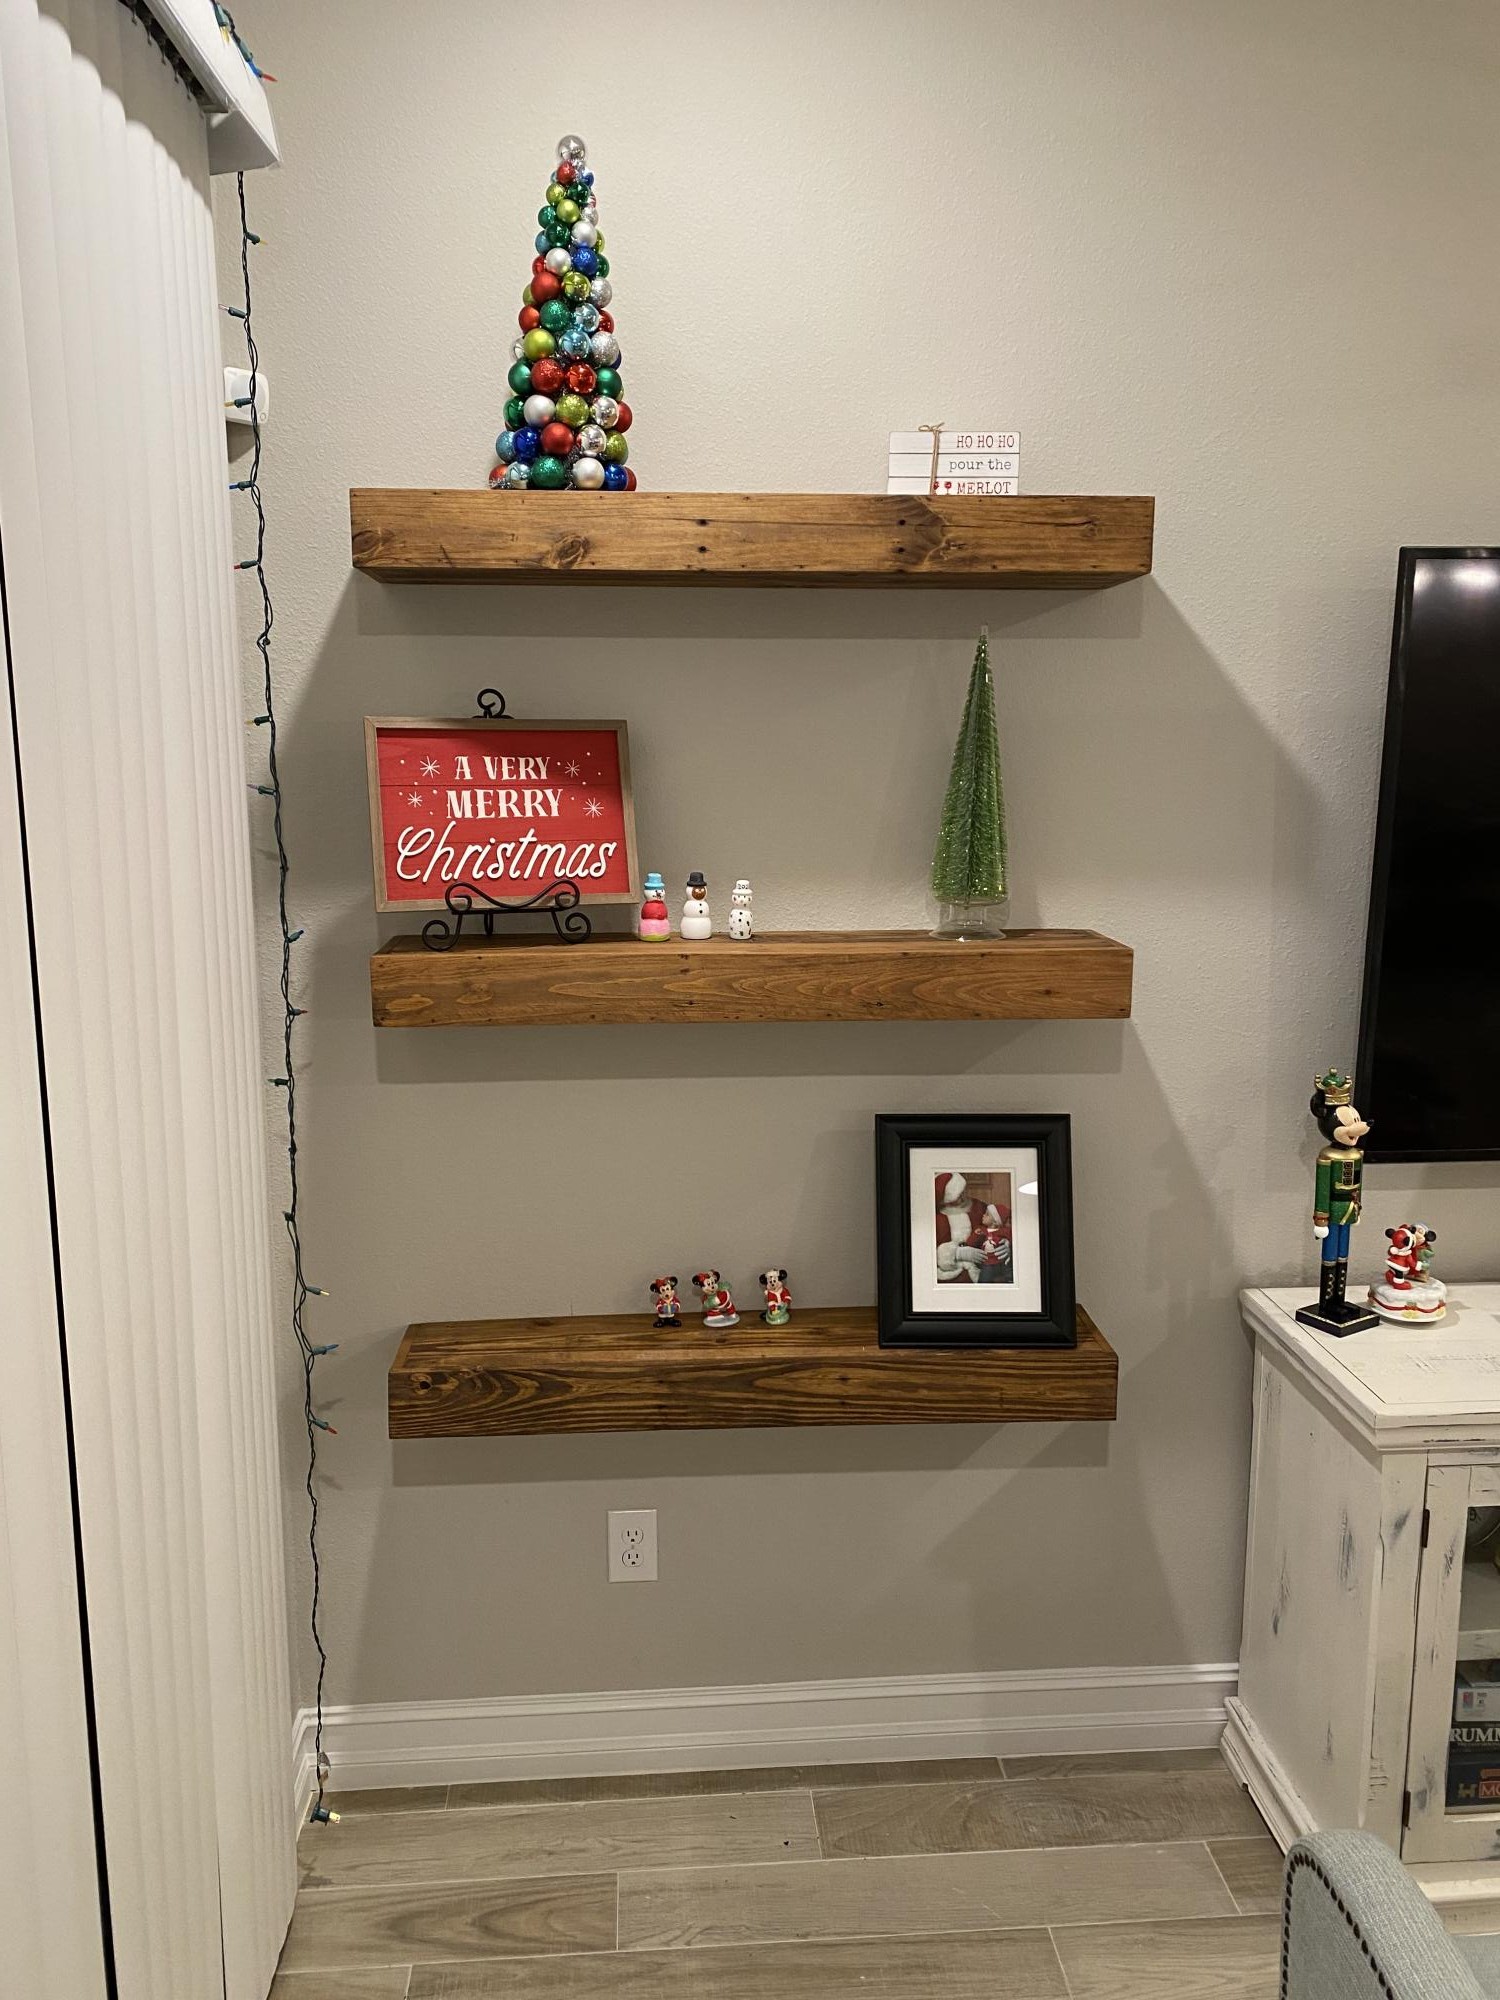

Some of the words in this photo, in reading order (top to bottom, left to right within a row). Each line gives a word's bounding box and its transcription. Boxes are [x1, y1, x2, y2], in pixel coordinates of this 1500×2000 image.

[956, 435, 973, 448] HO
[977, 435, 994, 448] HO
[998, 435, 1015, 448] HO
[949, 460, 984, 472] pour
[988, 458, 1012, 470] the
[957, 481, 1012, 495] MERLOT
[454, 755, 473, 780] A
[482, 756, 551, 781] VERY
[445, 788, 564, 819] MERRY
[396, 820, 617, 883] Christmas
